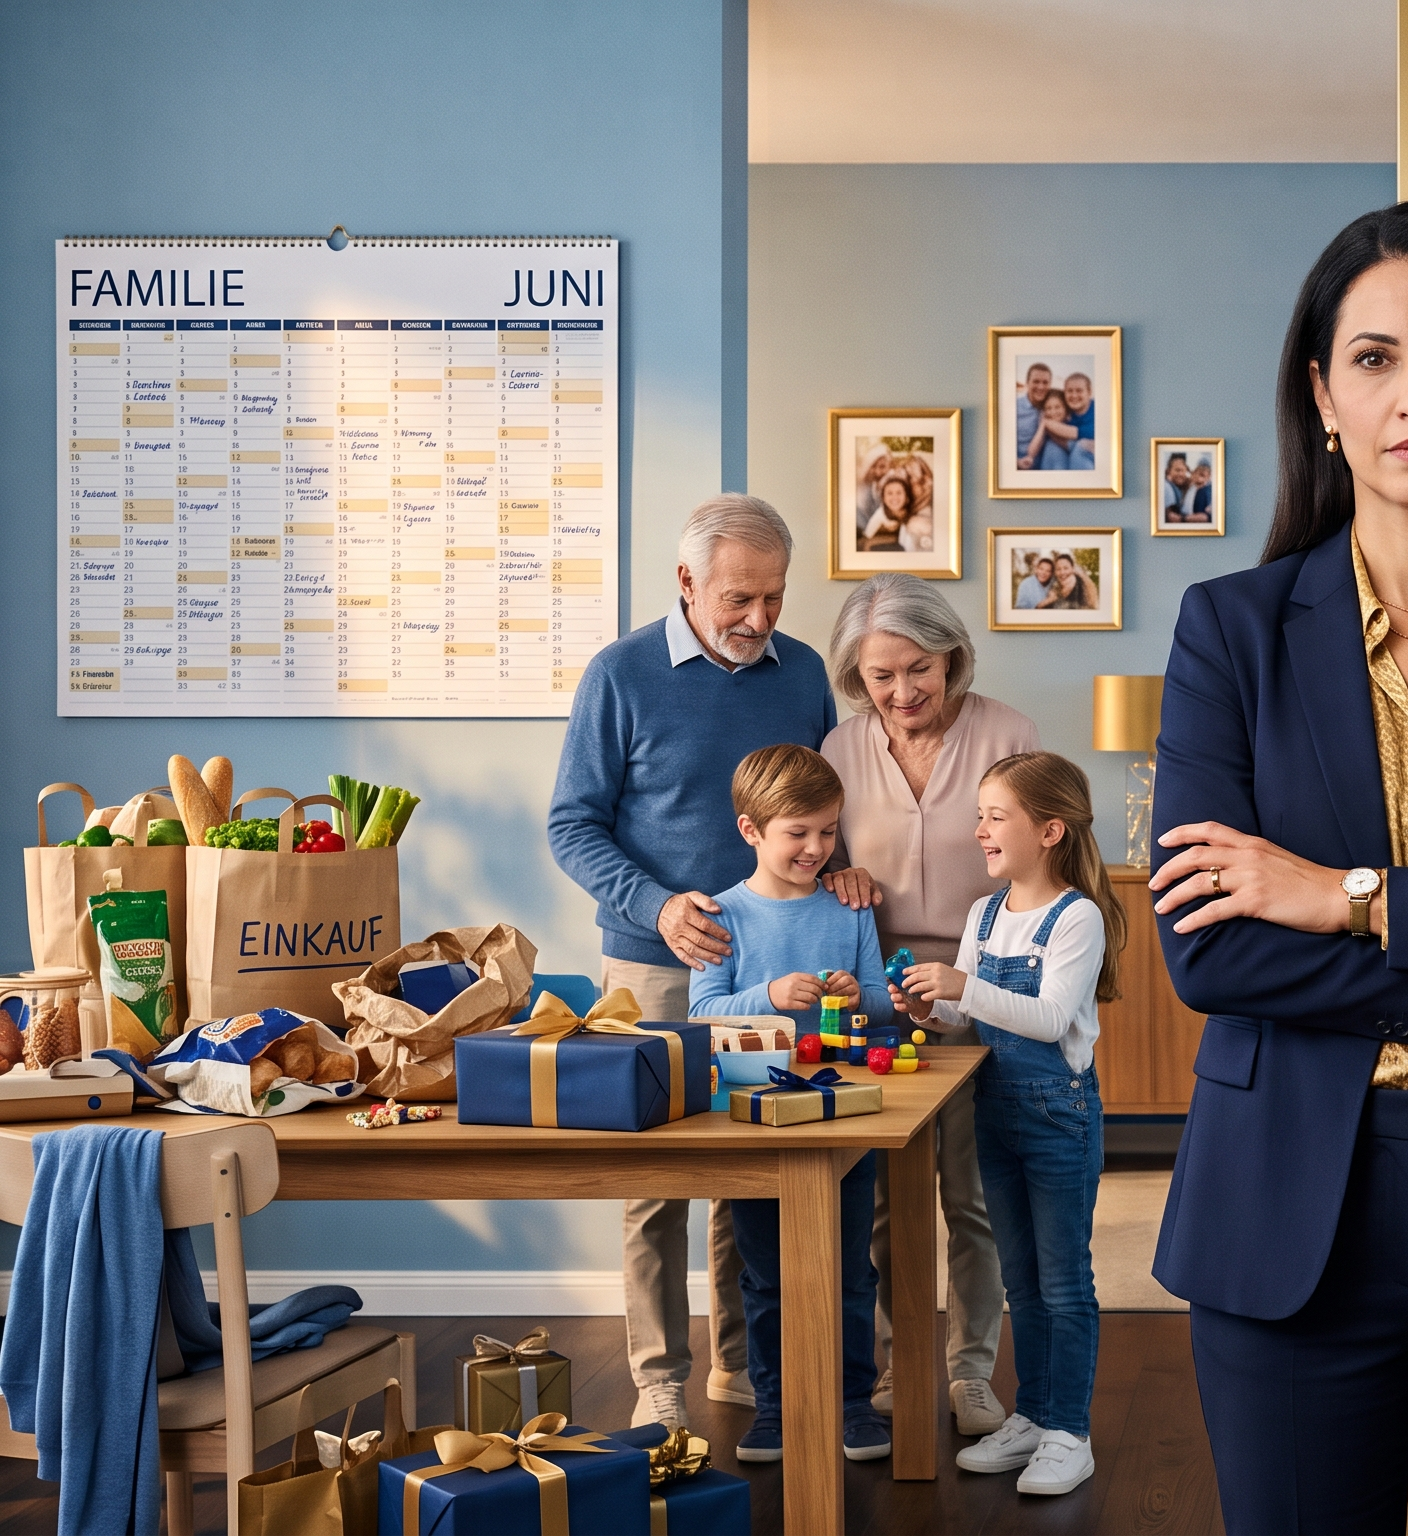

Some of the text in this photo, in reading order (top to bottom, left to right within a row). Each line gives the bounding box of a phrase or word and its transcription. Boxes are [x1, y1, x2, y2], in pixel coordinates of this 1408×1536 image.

[71, 269, 245, 307] FAMILIE
[503, 269, 604, 307] JUNI
[239, 914, 383, 957] EINKAUF
